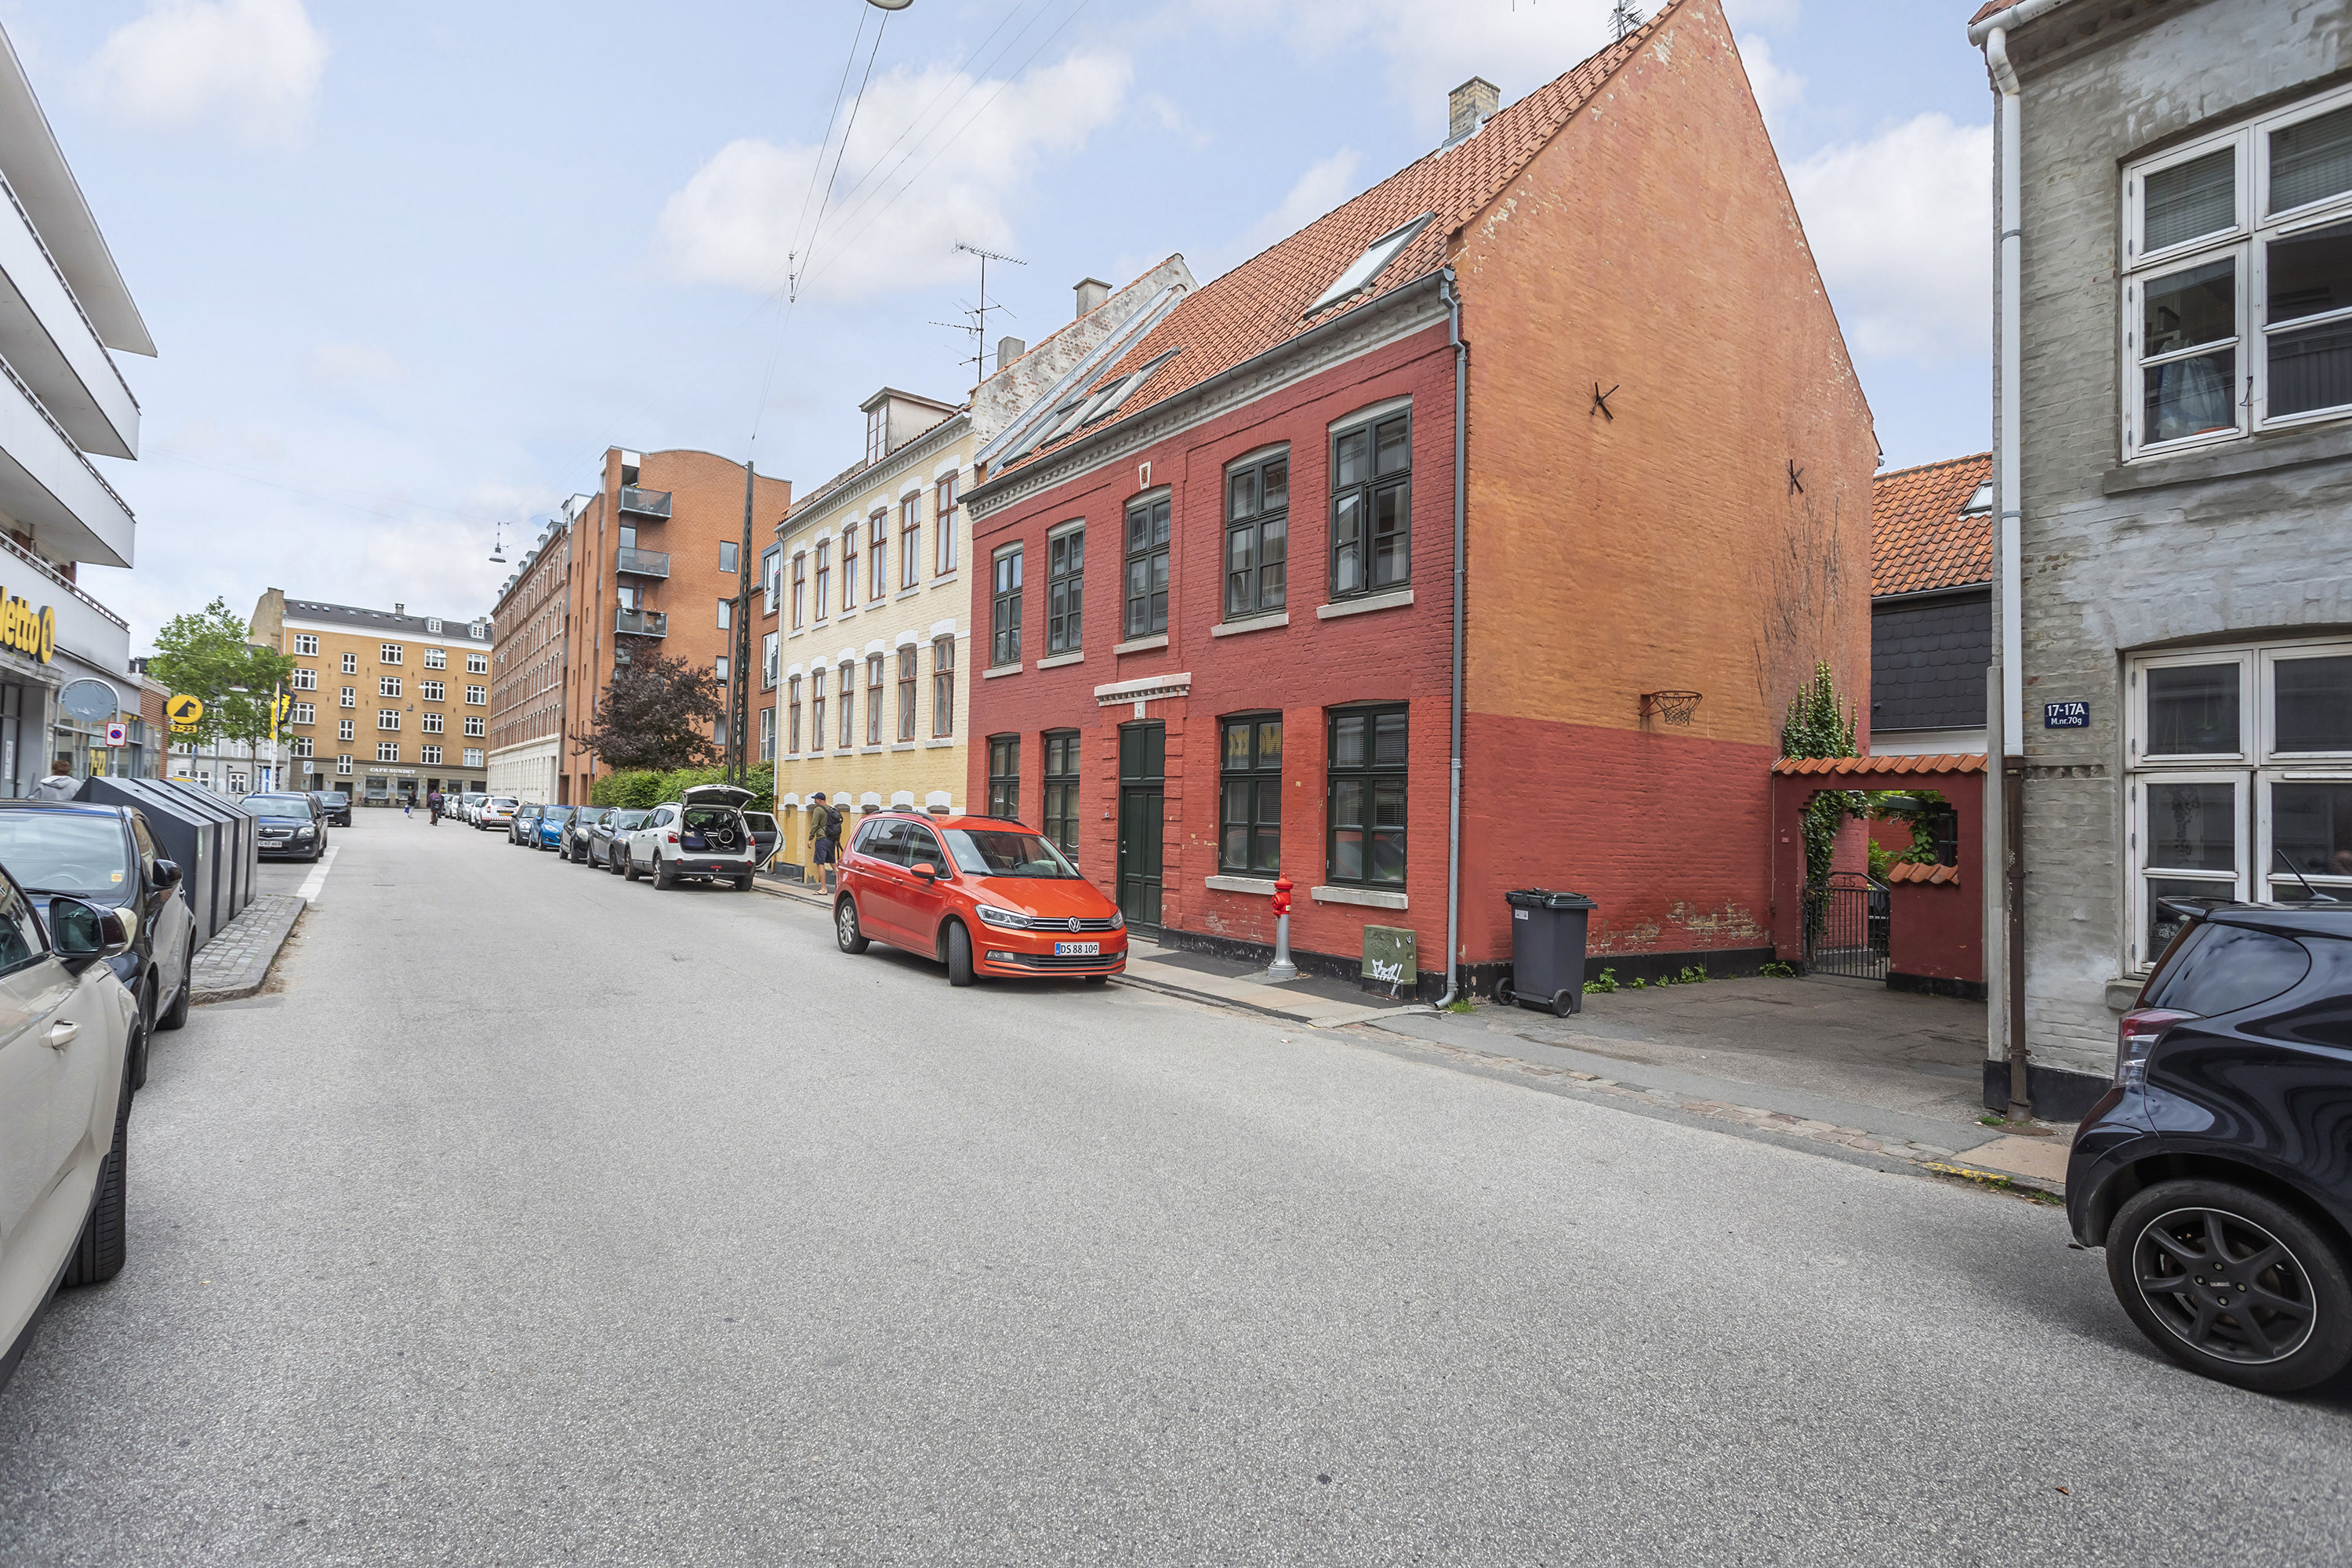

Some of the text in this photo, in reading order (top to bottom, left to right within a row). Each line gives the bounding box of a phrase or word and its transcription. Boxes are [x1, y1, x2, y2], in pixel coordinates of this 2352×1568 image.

[2047, 702, 2085, 717] 17-17A
[2051, 717, 2082, 726] M.nr.70g
[1061, 945, 1072, 953] DS
[1073, 945, 1083, 953] 88
[1084, 945, 1098, 953] 109
